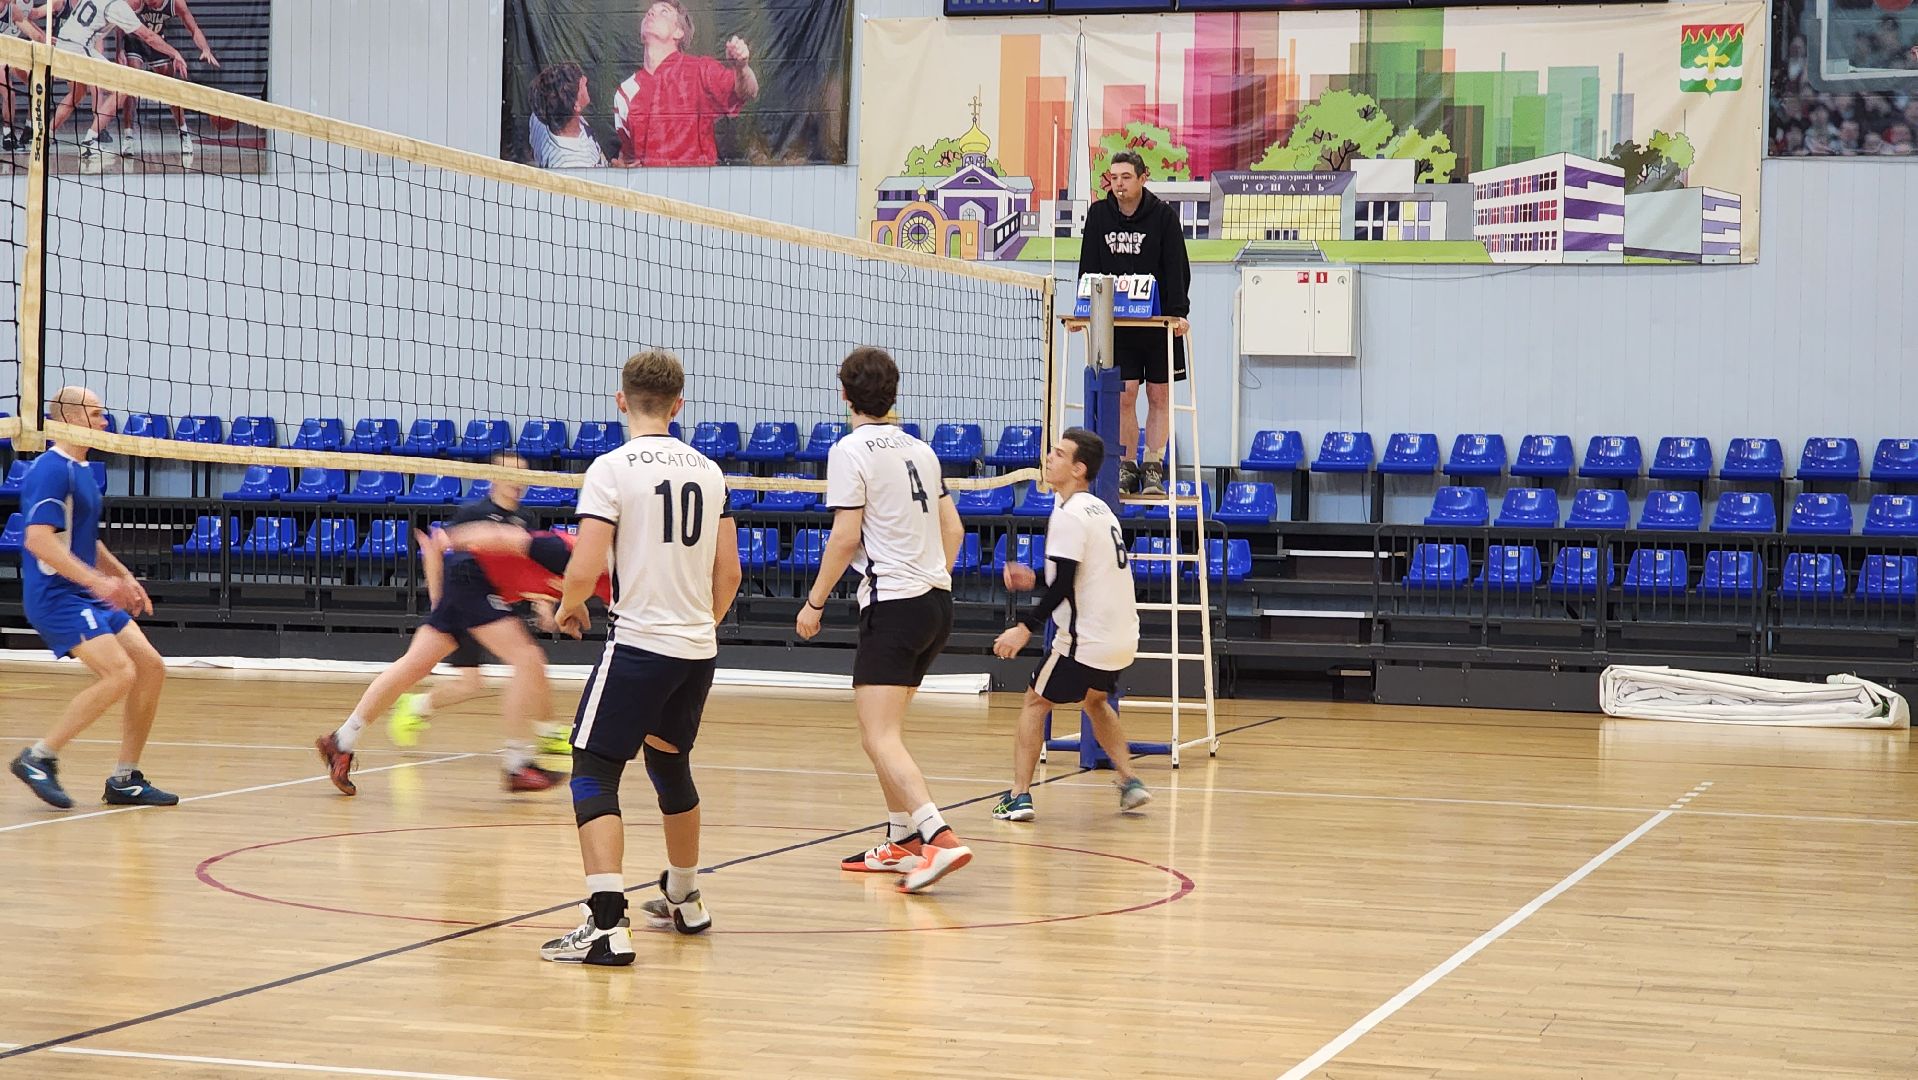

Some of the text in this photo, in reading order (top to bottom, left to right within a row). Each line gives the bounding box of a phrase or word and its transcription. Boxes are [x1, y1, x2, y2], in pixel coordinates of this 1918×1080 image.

[34, 98, 43, 162] Schelde
[1242, 183, 1325, 192] РОШАЛЬ
[1104, 231, 1147, 243] LOONEY
[1109, 242, 1141, 255] TUNES
[1134, 279, 1150, 297] 14
[1076, 304, 1091, 313] HO
[1128, 304, 1151, 314] GUEST
[865, 433, 915, 453] РОСАТО
[626, 450, 710, 471] РОСАТОМ
[904, 459, 929, 513] 4
[654, 479, 703, 547] 10
[80, 608, 98, 630] 1
